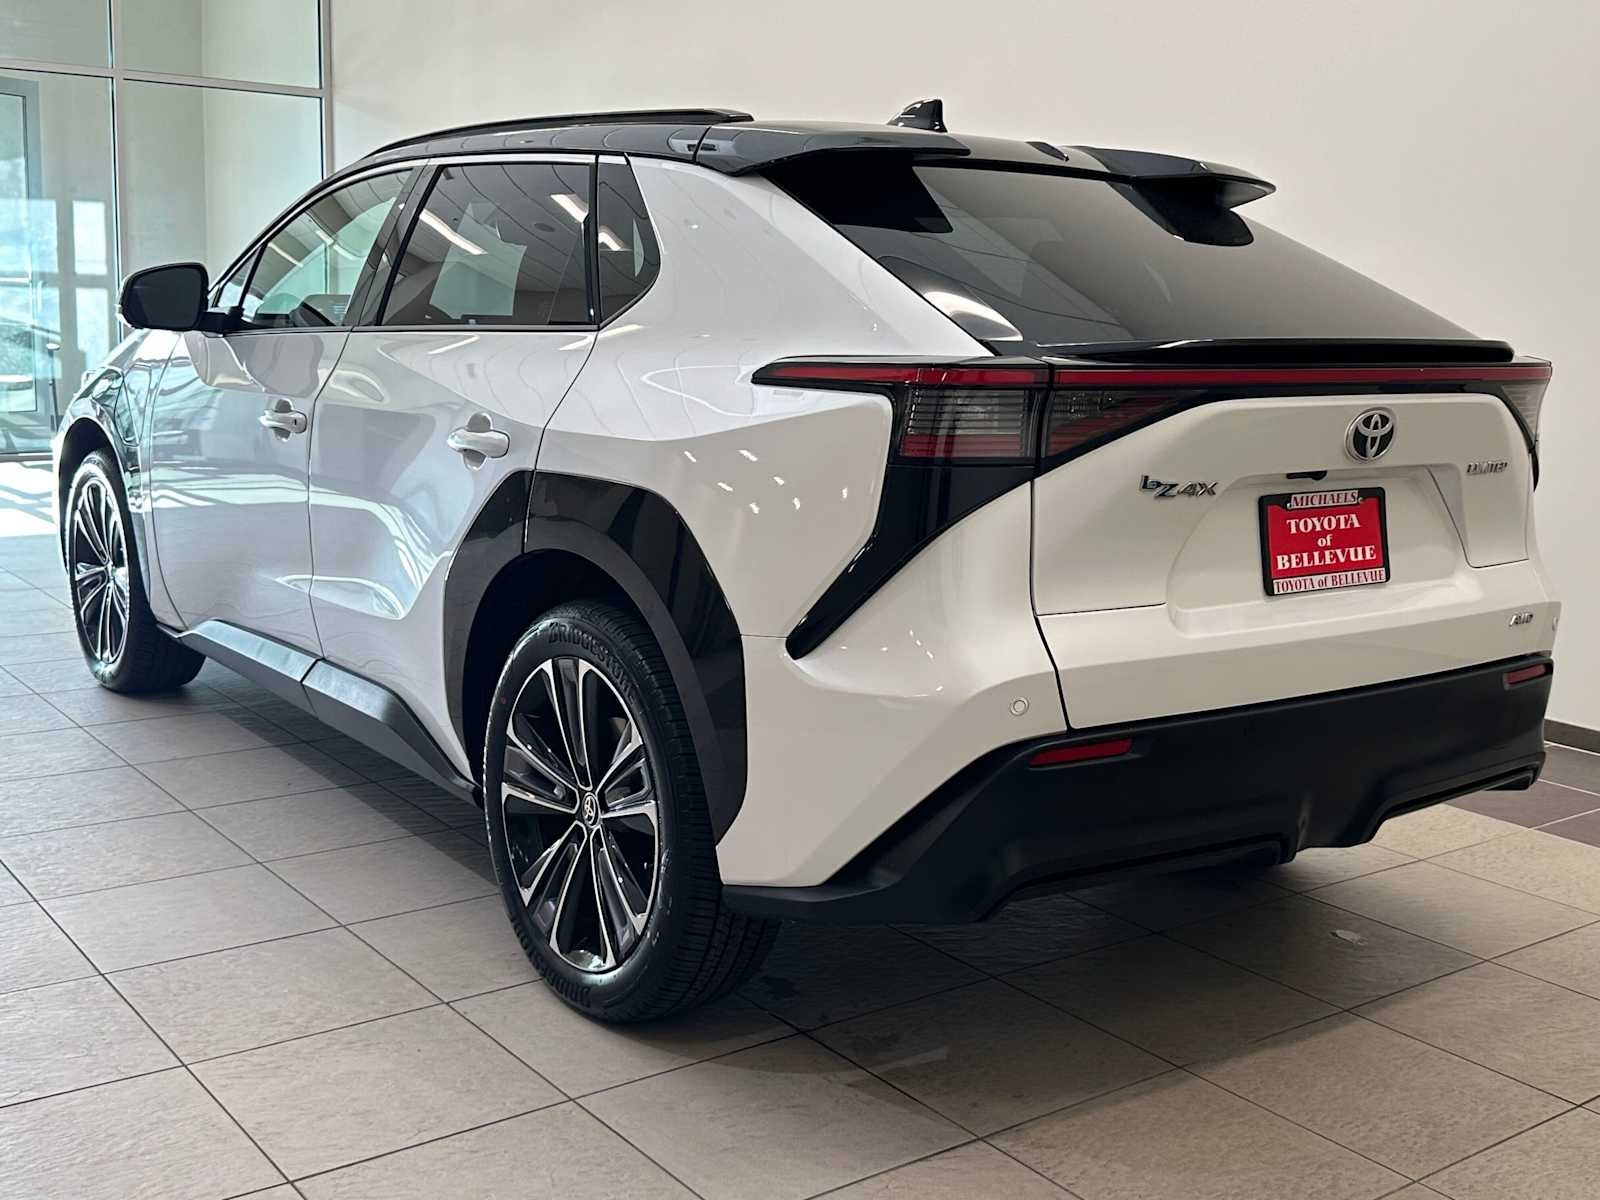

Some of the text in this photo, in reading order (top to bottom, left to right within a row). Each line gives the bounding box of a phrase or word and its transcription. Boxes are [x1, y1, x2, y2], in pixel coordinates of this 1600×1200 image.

[1291, 491, 1358, 508] MICHAELS
[1286, 513, 1361, 534] TOYOTA
[1317, 534, 1333, 547] of
[1276, 545, 1377, 570] BELLEVUE
[1274, 569, 1385, 593] TOYOTA of BELLEVUE
